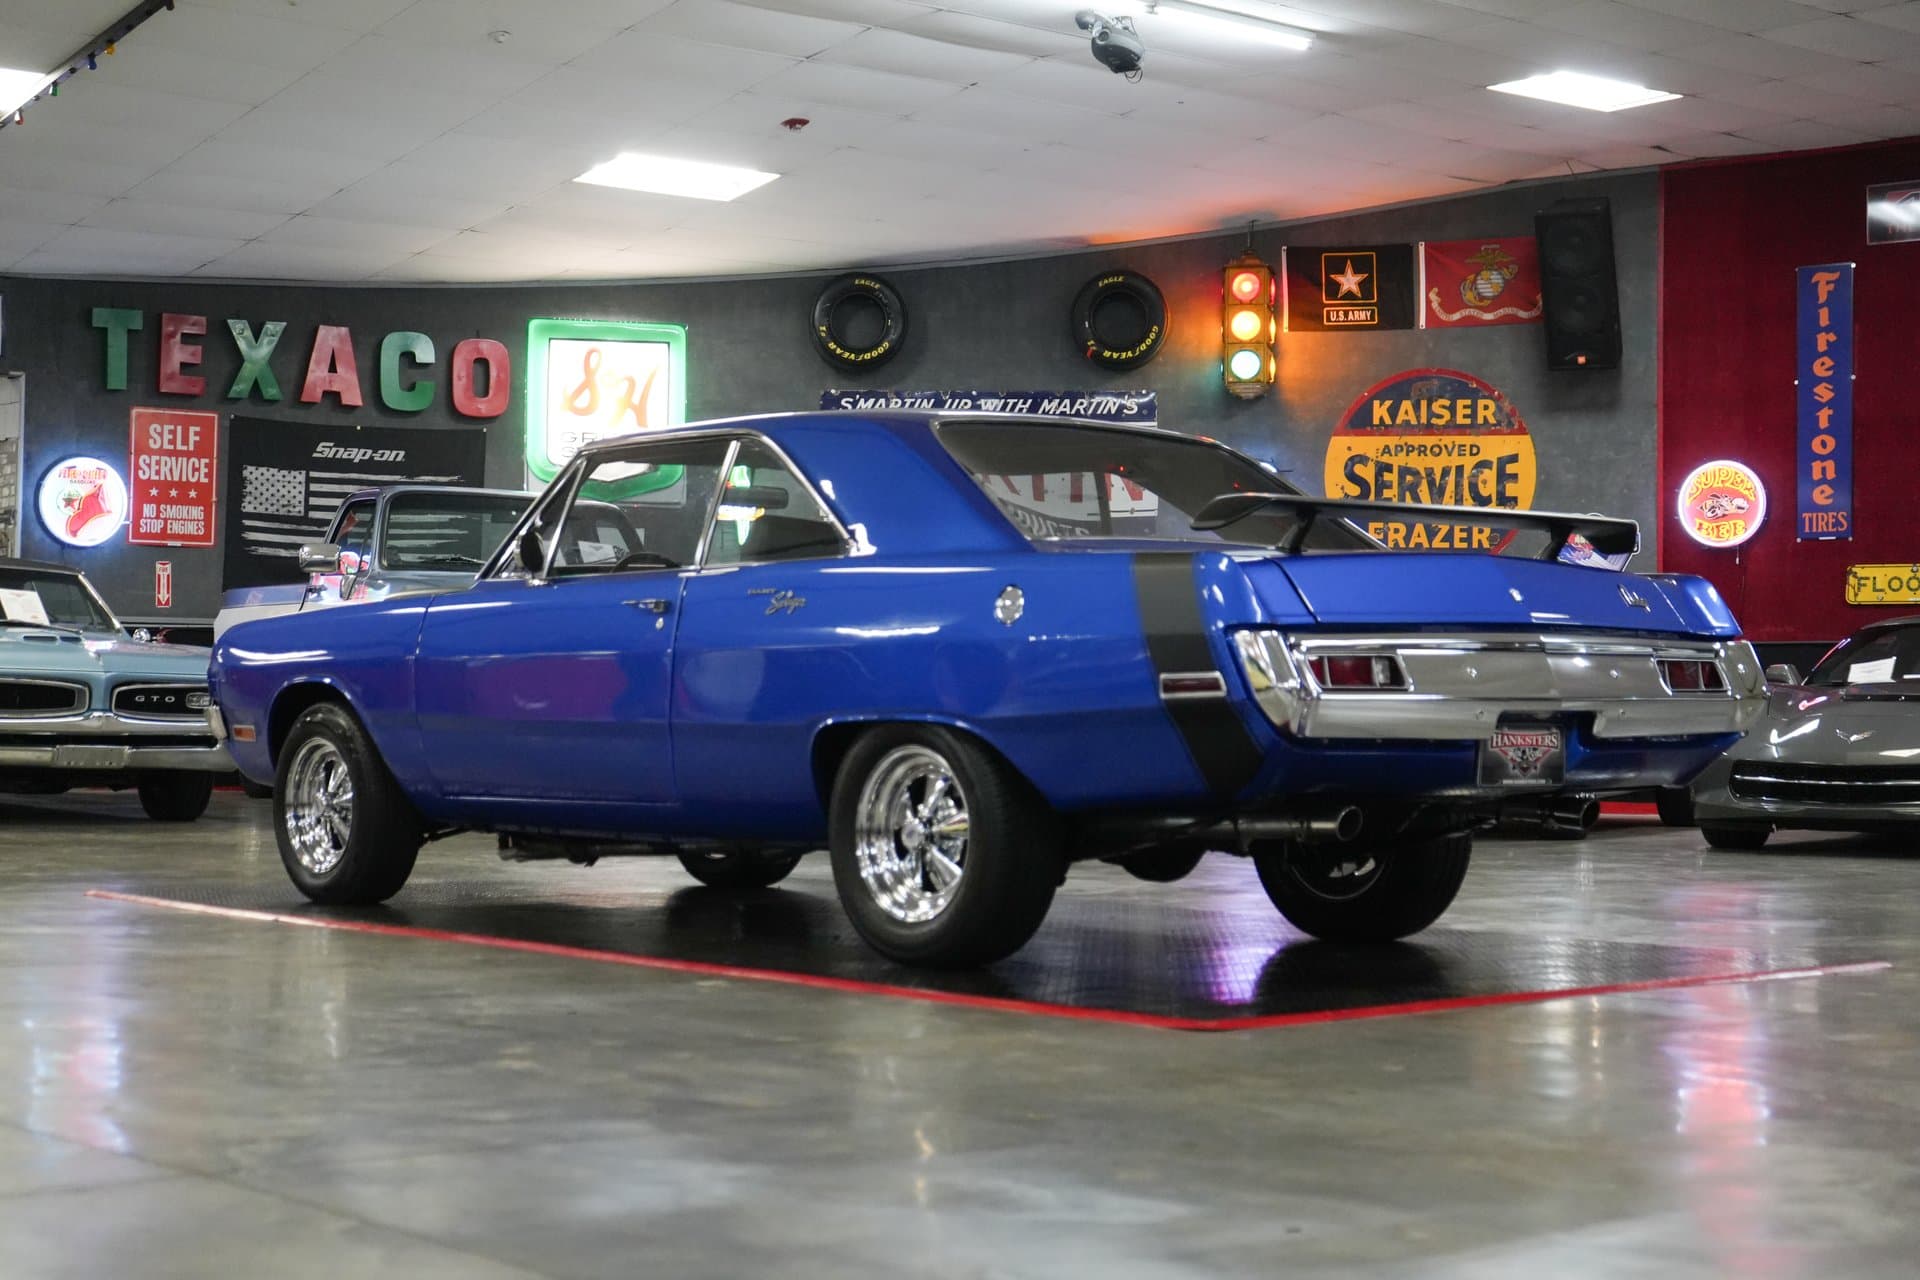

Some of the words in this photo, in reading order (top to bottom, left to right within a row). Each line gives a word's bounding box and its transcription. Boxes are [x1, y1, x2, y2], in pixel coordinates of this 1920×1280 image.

[855, 279, 880, 289] EAGLE
[1098, 276, 1124, 287] EAGLE
[1329, 311, 1346, 321] U.S.
[1347, 310, 1372, 321] ARMY
[827, 341, 890, 361] GOODYEAR
[1102, 325, 1159, 359] GOODYEAR
[91, 307, 511, 417] TEXACO
[1811, 271, 1841, 506] Firestone
[943, 398, 973, 410] UP
[977, 398, 1033, 414] WITH
[1038, 395, 1139, 415] MARTIN'S
[1372, 398, 1497, 426] KAISER
[148, 424, 201, 451] SELF
[312, 441, 405, 463] Snap-on
[1381, 444, 1481, 457] APPROVED
[138, 454, 210, 483] SERVICE
[1344, 453, 1519, 508] SERVICE
[1686, 466, 1757, 506] SUPER
[143, 503, 156, 518] NO
[160, 504, 204, 519] SMOKING
[140, 518, 164, 534] STOP
[167, 520, 205, 535] ENGINES
[1696, 518, 1746, 541] BEE
[1802, 512, 1848, 533] TIRES
[1368, 521, 1492, 549] FRAZER
[135, 695, 175, 703] GTO
[1492, 734, 1558, 748] HANKSTERS
